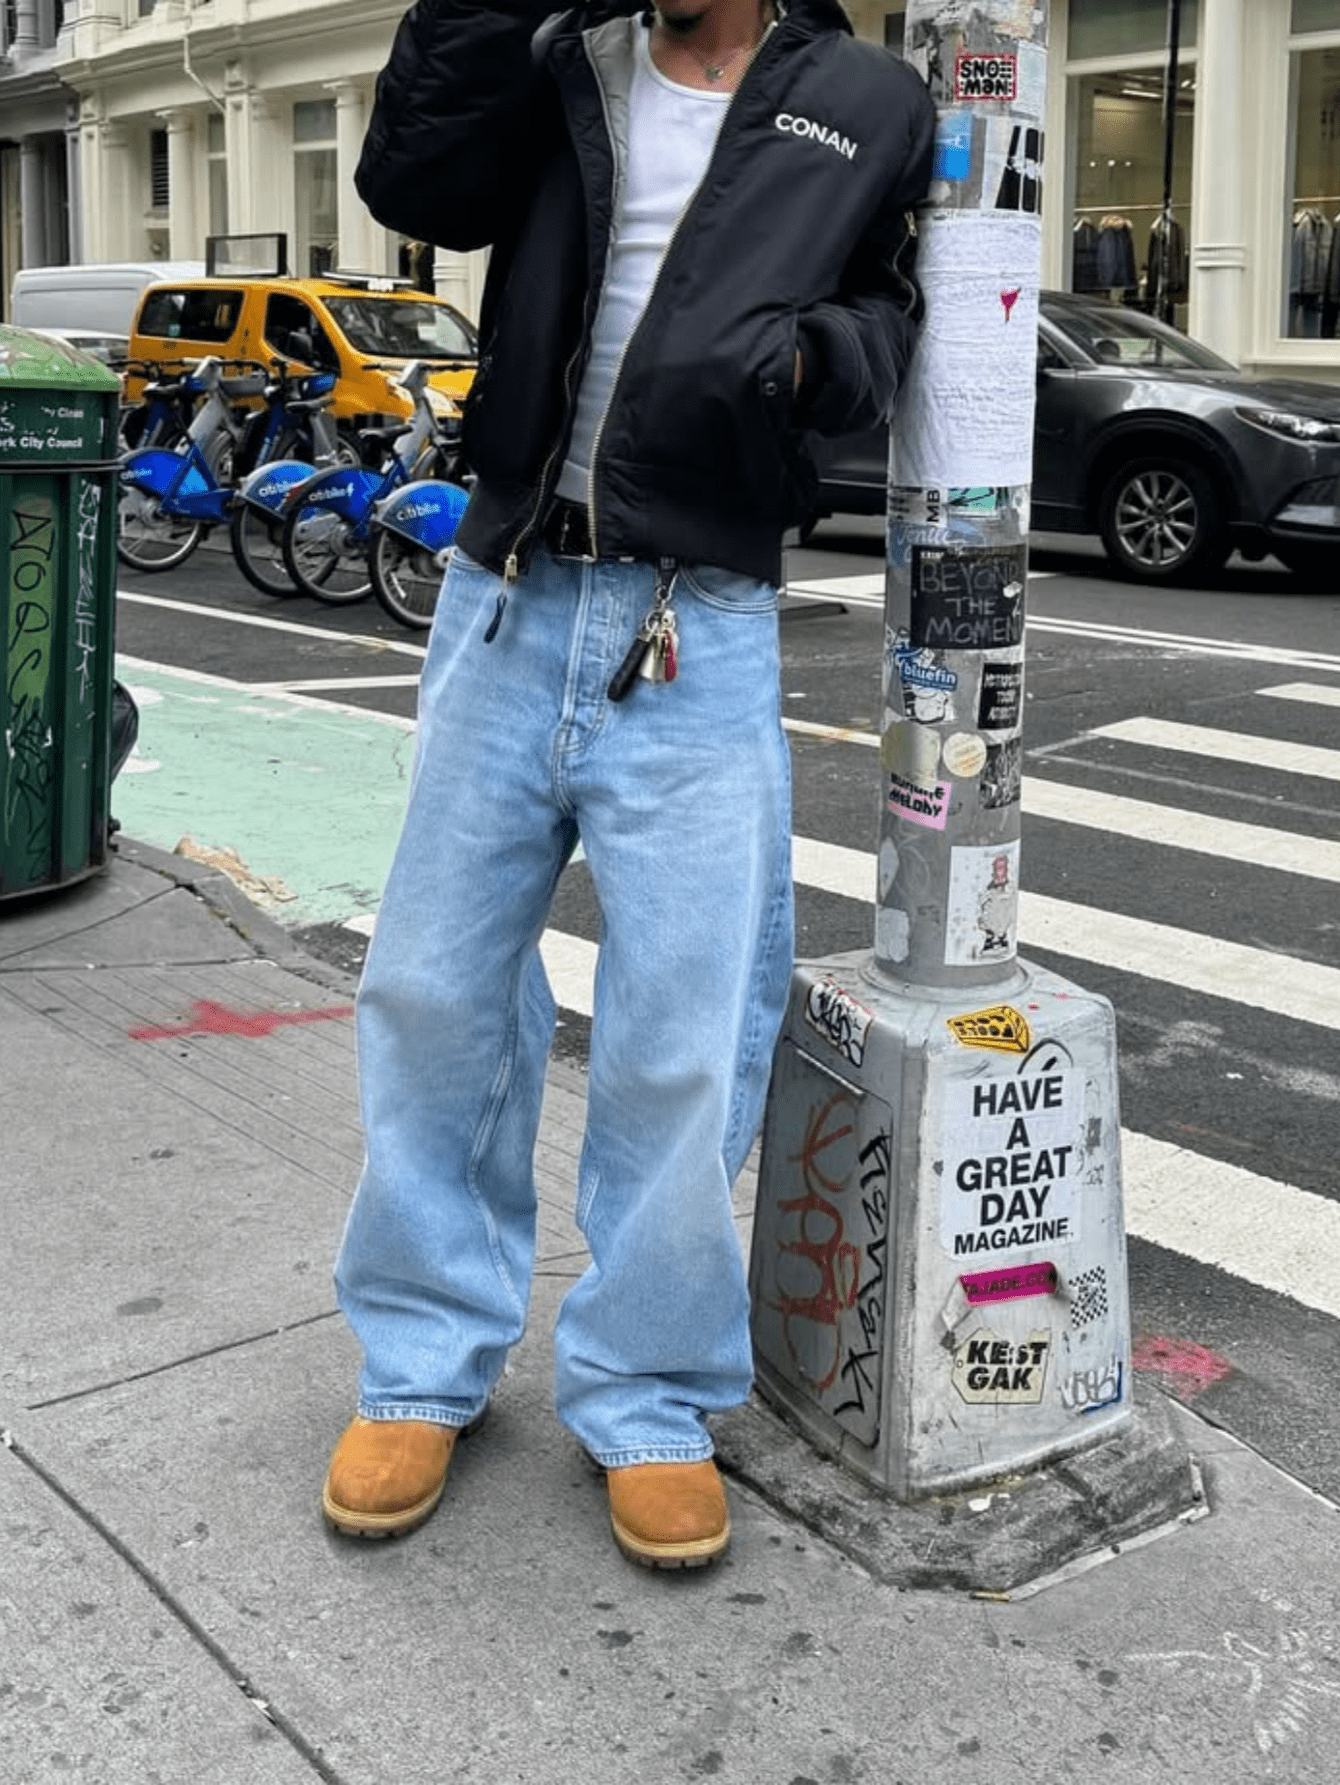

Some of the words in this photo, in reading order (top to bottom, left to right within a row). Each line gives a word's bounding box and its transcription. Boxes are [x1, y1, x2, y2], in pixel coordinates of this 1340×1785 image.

[775, 113, 858, 160] CONAN
[20, 436, 45, 450] City
[47, 436, 83, 448] Council
[944, 597, 996, 617] THE
[904, 662, 957, 685] bluefin
[973, 1075, 1063, 1117] HAVE
[1006, 1117, 1030, 1150] A
[956, 1145, 1073, 1192] GREAT
[980, 1184, 1051, 1226] DAY
[967, 1366, 1034, 1390] GAK
